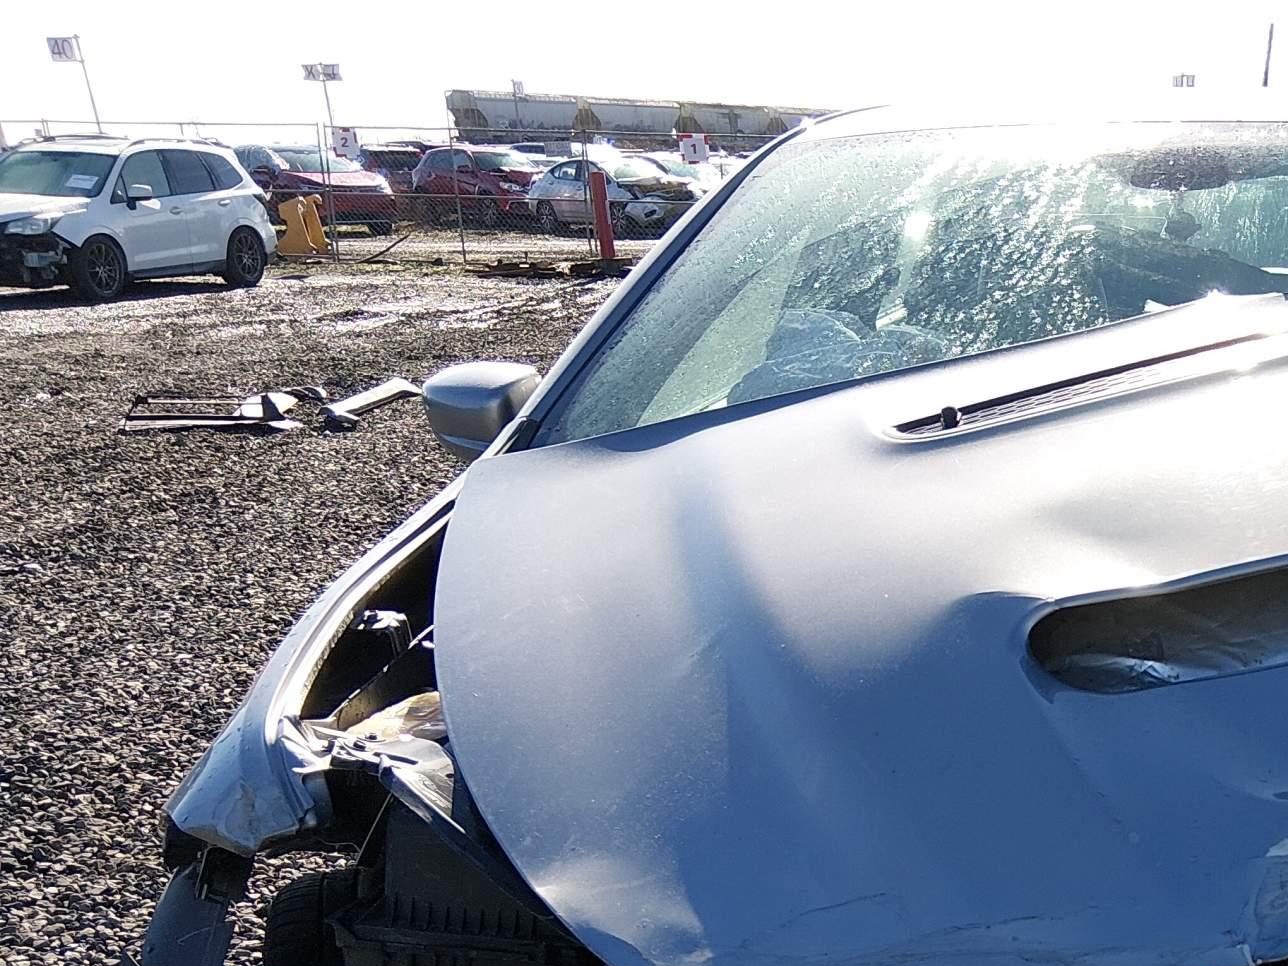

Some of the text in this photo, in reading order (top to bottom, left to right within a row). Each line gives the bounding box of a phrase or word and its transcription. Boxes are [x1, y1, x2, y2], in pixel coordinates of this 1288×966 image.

[51, 39, 73, 59] 40
[340, 137, 349, 147] 2
[690, 143, 697, 154] 1
